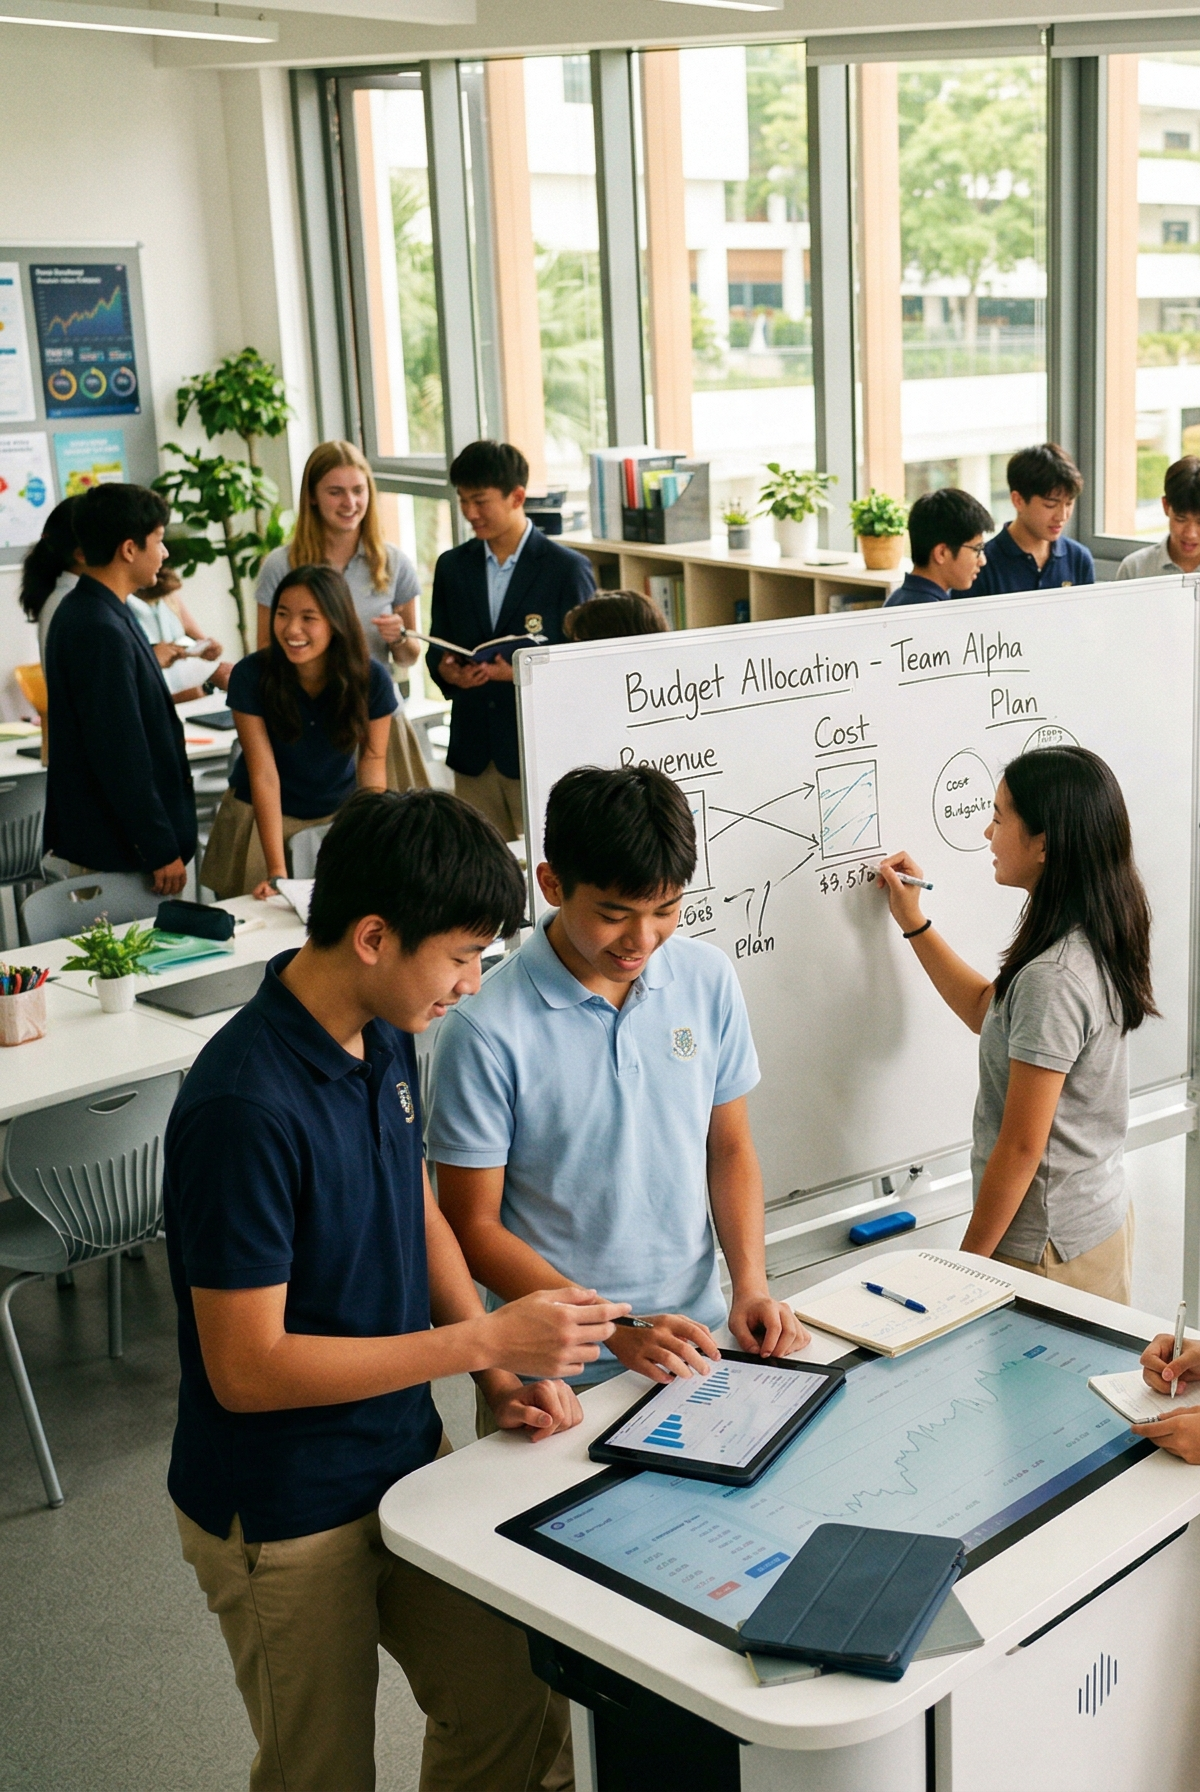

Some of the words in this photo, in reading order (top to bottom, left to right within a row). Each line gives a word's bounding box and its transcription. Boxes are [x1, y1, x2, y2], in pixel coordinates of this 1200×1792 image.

[625, 663, 725, 720] Budget
[741, 652, 859, 695] Allocation
[890, 637, 951, 673] Team
[962, 631, 1023, 677] Alpha
[990, 688, 1038, 719] Plan
[815, 714, 870, 748] Cost
